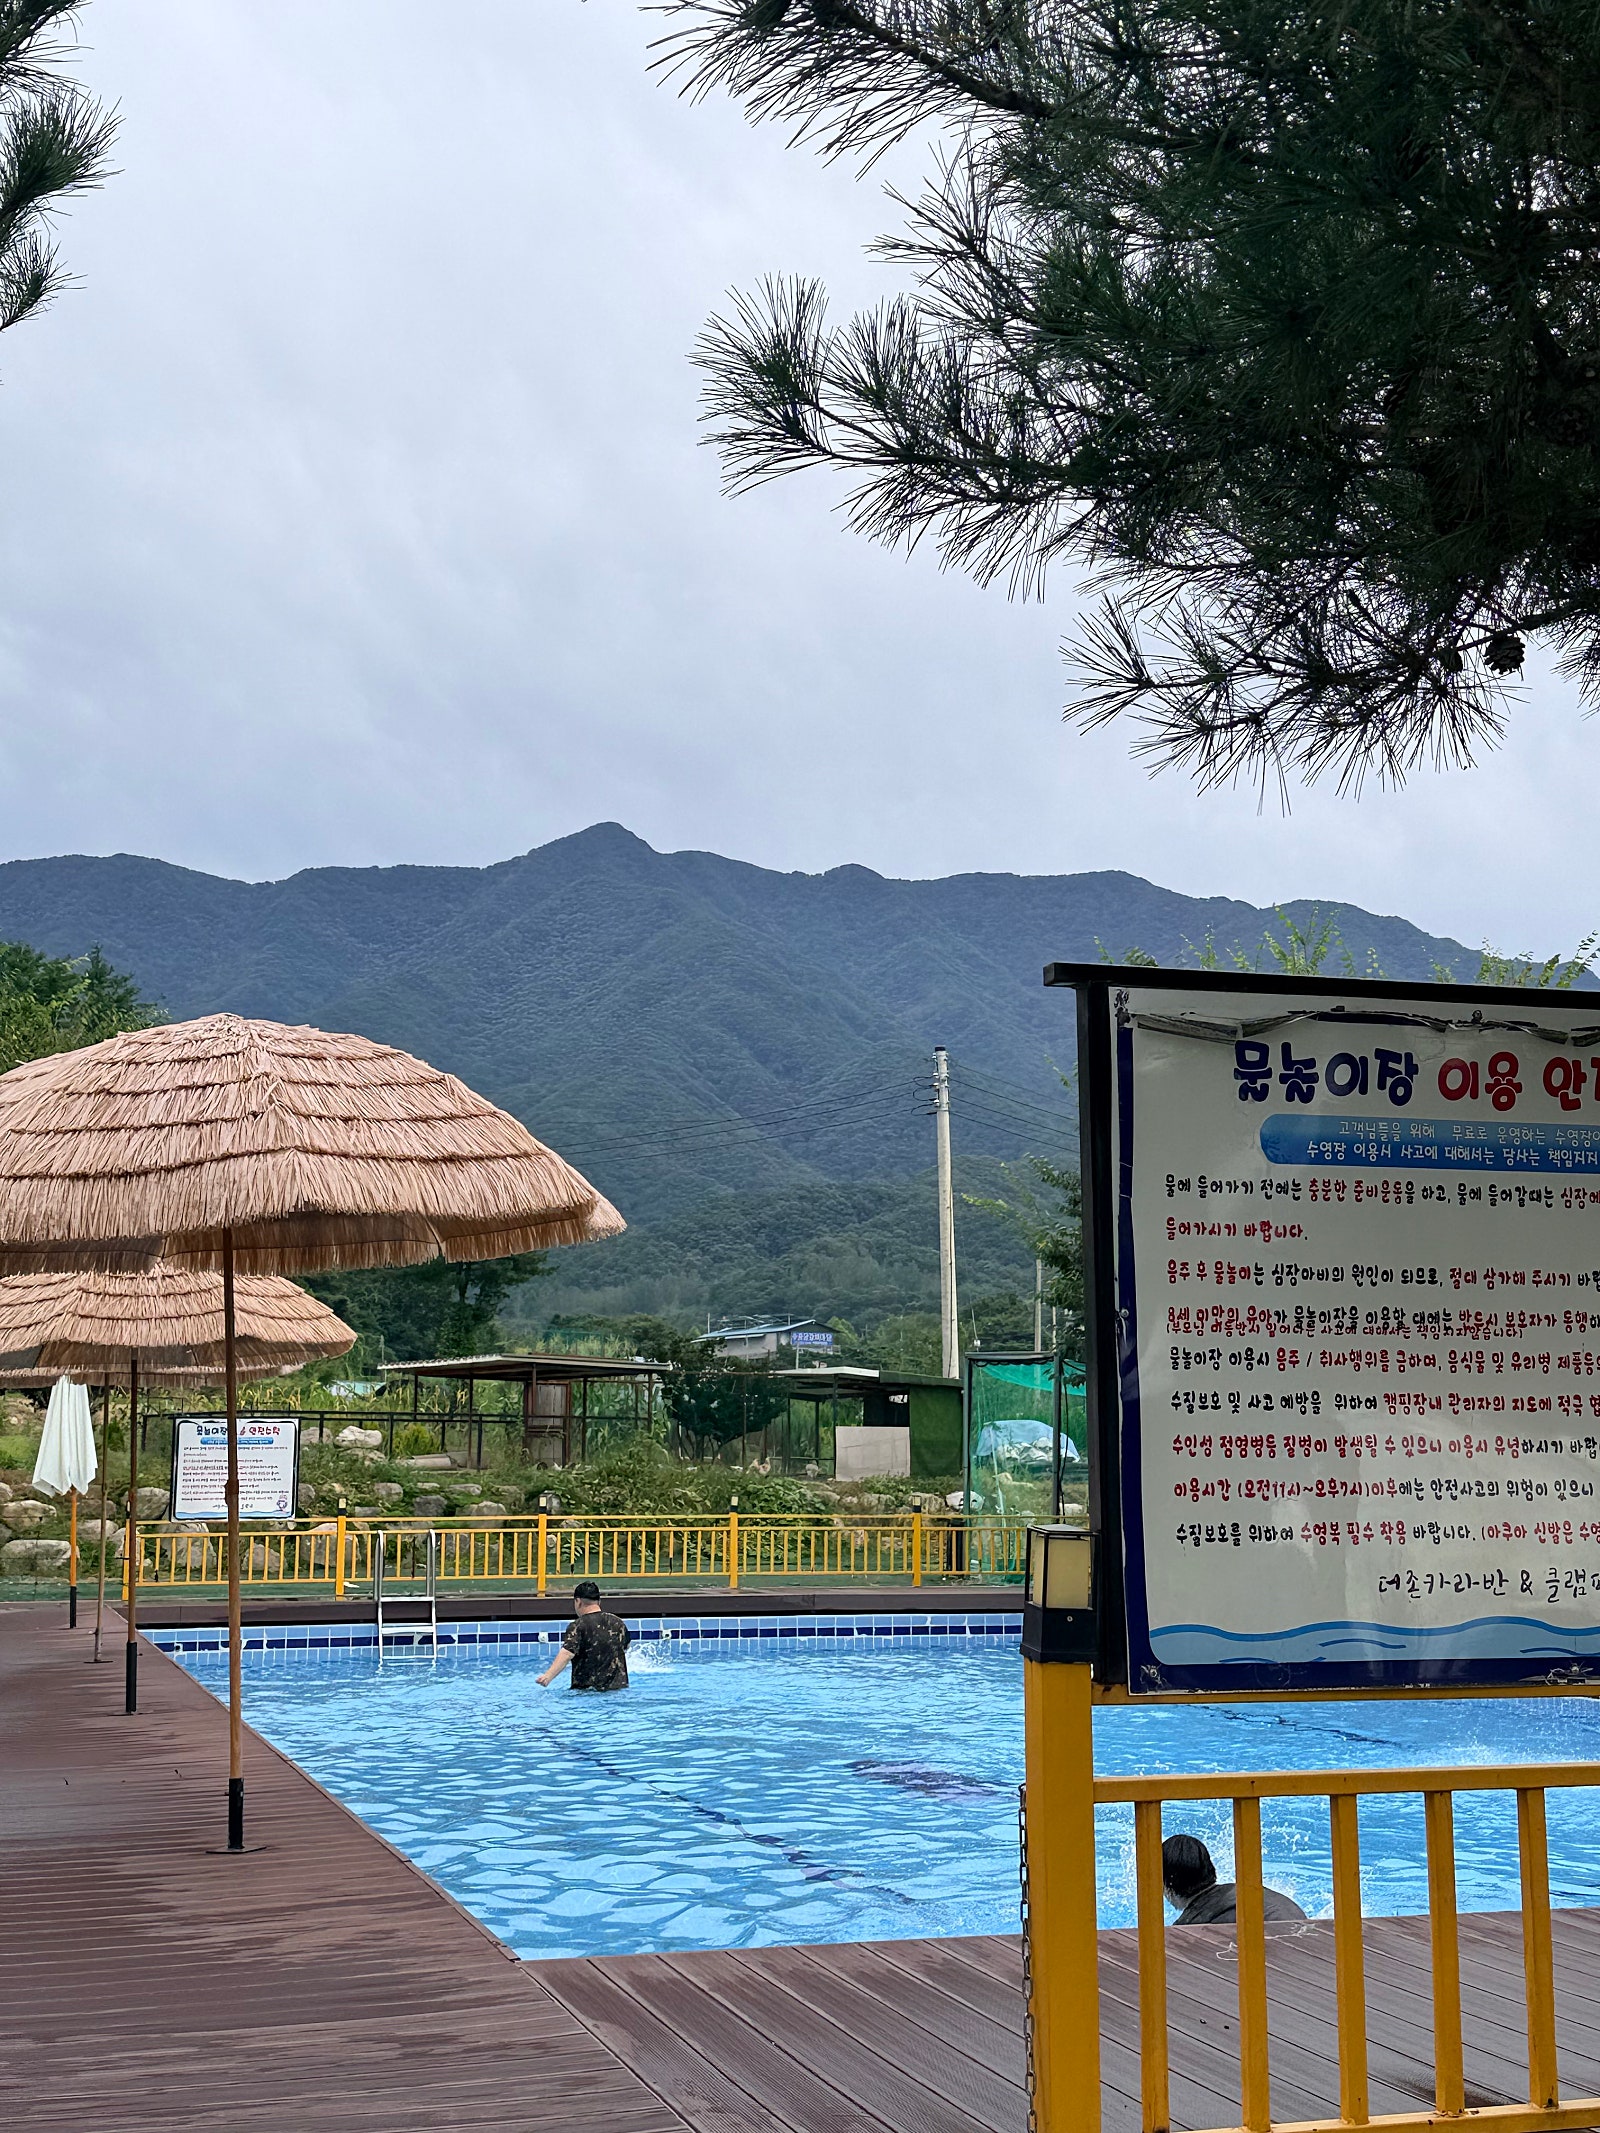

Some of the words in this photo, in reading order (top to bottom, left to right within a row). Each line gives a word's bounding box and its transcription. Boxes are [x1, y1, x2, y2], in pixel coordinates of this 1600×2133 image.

[1233, 1040, 1419, 1107] 물놀이장
[1438, 1051, 1523, 1112] 이용
[1339, 1121, 1401, 1142] 고객님들을
[1410, 1123, 1435, 1139] 위해
[1452, 1125, 1488, 1142] 무료로
[1497, 1126, 1546, 1145] 운영하는
[1307, 1141, 1347, 1160] 수영장
[1353, 1142, 1391, 1162] 이용시
[1400, 1144, 1438, 1160] 사고에
[1444, 1145, 1495, 1165] 대해서는
[1502, 1148, 1540, 1166] 당사는
[1165, 1173, 1191, 1198] 물에
[1198, 1175, 1254, 1199] 들어가기
[1260, 1178, 1302, 1201] 전에는
[1308, 1178, 1347, 1202] 충분한
[1354, 1179, 1415, 1204] 준비운동을
[1421, 1184, 1451, 1204] 하고,
[1457, 1182, 1482, 1206] 물에
[1487, 1183, 1554, 1208] 들어갈때는
[1166, 1216, 1237, 1241] 들어가시기
[1243, 1219, 1308, 1243] 바랍니다.
[1167, 1259, 1190, 1284] 음주
[1196, 1260, 1208, 1281] 후
[1214, 1260, 1264, 1286] 물놀이는
[1272, 1262, 1345, 1286] 심장마비의
[1351, 1264, 1394, 1287] 원인이
[1401, 1267, 1443, 1288] 되므로,
[1450, 1267, 1477, 1290] 절대
[1483, 1267, 1525, 1290] 삼가해
[1531, 1269, 1571, 1288] 주시기
[1167, 1306, 1190, 1323] 8세
[1505, 1310, 1557, 1329] 보호자가
[1169, 1346, 1223, 1371] 물놀이장
[1228, 1347, 1270, 1371] 이용시
[1276, 1347, 1300, 1372] 음주
[1319, 1349, 1390, 1373] 취사행위를
[1396, 1350, 1442, 1374] 금하며,
[1448, 1350, 1485, 1374] 음식물
[1491, 1351, 1504, 1374] 및
[1511, 1351, 1551, 1375] 유리병
[1170, 1390, 1222, 1415] 수질보호
[1227, 1391, 1241, 1415] 및
[1247, 1393, 1275, 1411] 사고
[1280, 1390, 1322, 1415] 예방을
[1334, 1393, 1378, 1411] 위하여
[1383, 1392, 1442, 1416] 캠핑장내
[1448, 1392, 1505, 1416] 관리자의
[1511, 1395, 1552, 1413] 지도에
[1557, 1394, 1583, 1417] 적극
[1172, 1434, 1213, 1458] 수인성
[1283, 1434, 1328, 1459] 질병이
[1334, 1434, 1378, 1459] 발생될
[1385, 1435, 1396, 1455] 수
[1401, 1435, 1442, 1458] 있으니
[1449, 1434, 1488, 1459] 이용시
[1494, 1435, 1564, 1459] 유념하시기
[1570, 1436, 1600, 1460] 바랍
[1174, 1477, 1232, 1502] 이용시간
[1430, 1478, 1500, 1501] 안전사고의
[1506, 1478, 1548, 1501] 위험이
[1554, 1479, 1594, 1501] 있으니
[1176, 1522, 1242, 1547] 수질보호를
[1249, 1524, 1294, 1542] 위하여
[1300, 1521, 1341, 1545] 수영복
[1347, 1522, 1375, 1545] 필수
[1380, 1520, 1406, 1545] 착용
[1413, 1521, 1476, 1545] 바랍니다.
[1481, 1522, 1527, 1541] (아쿠아
[1534, 1520, 1573, 1545] 신발은
[1520, 1569, 1533, 1596] &
